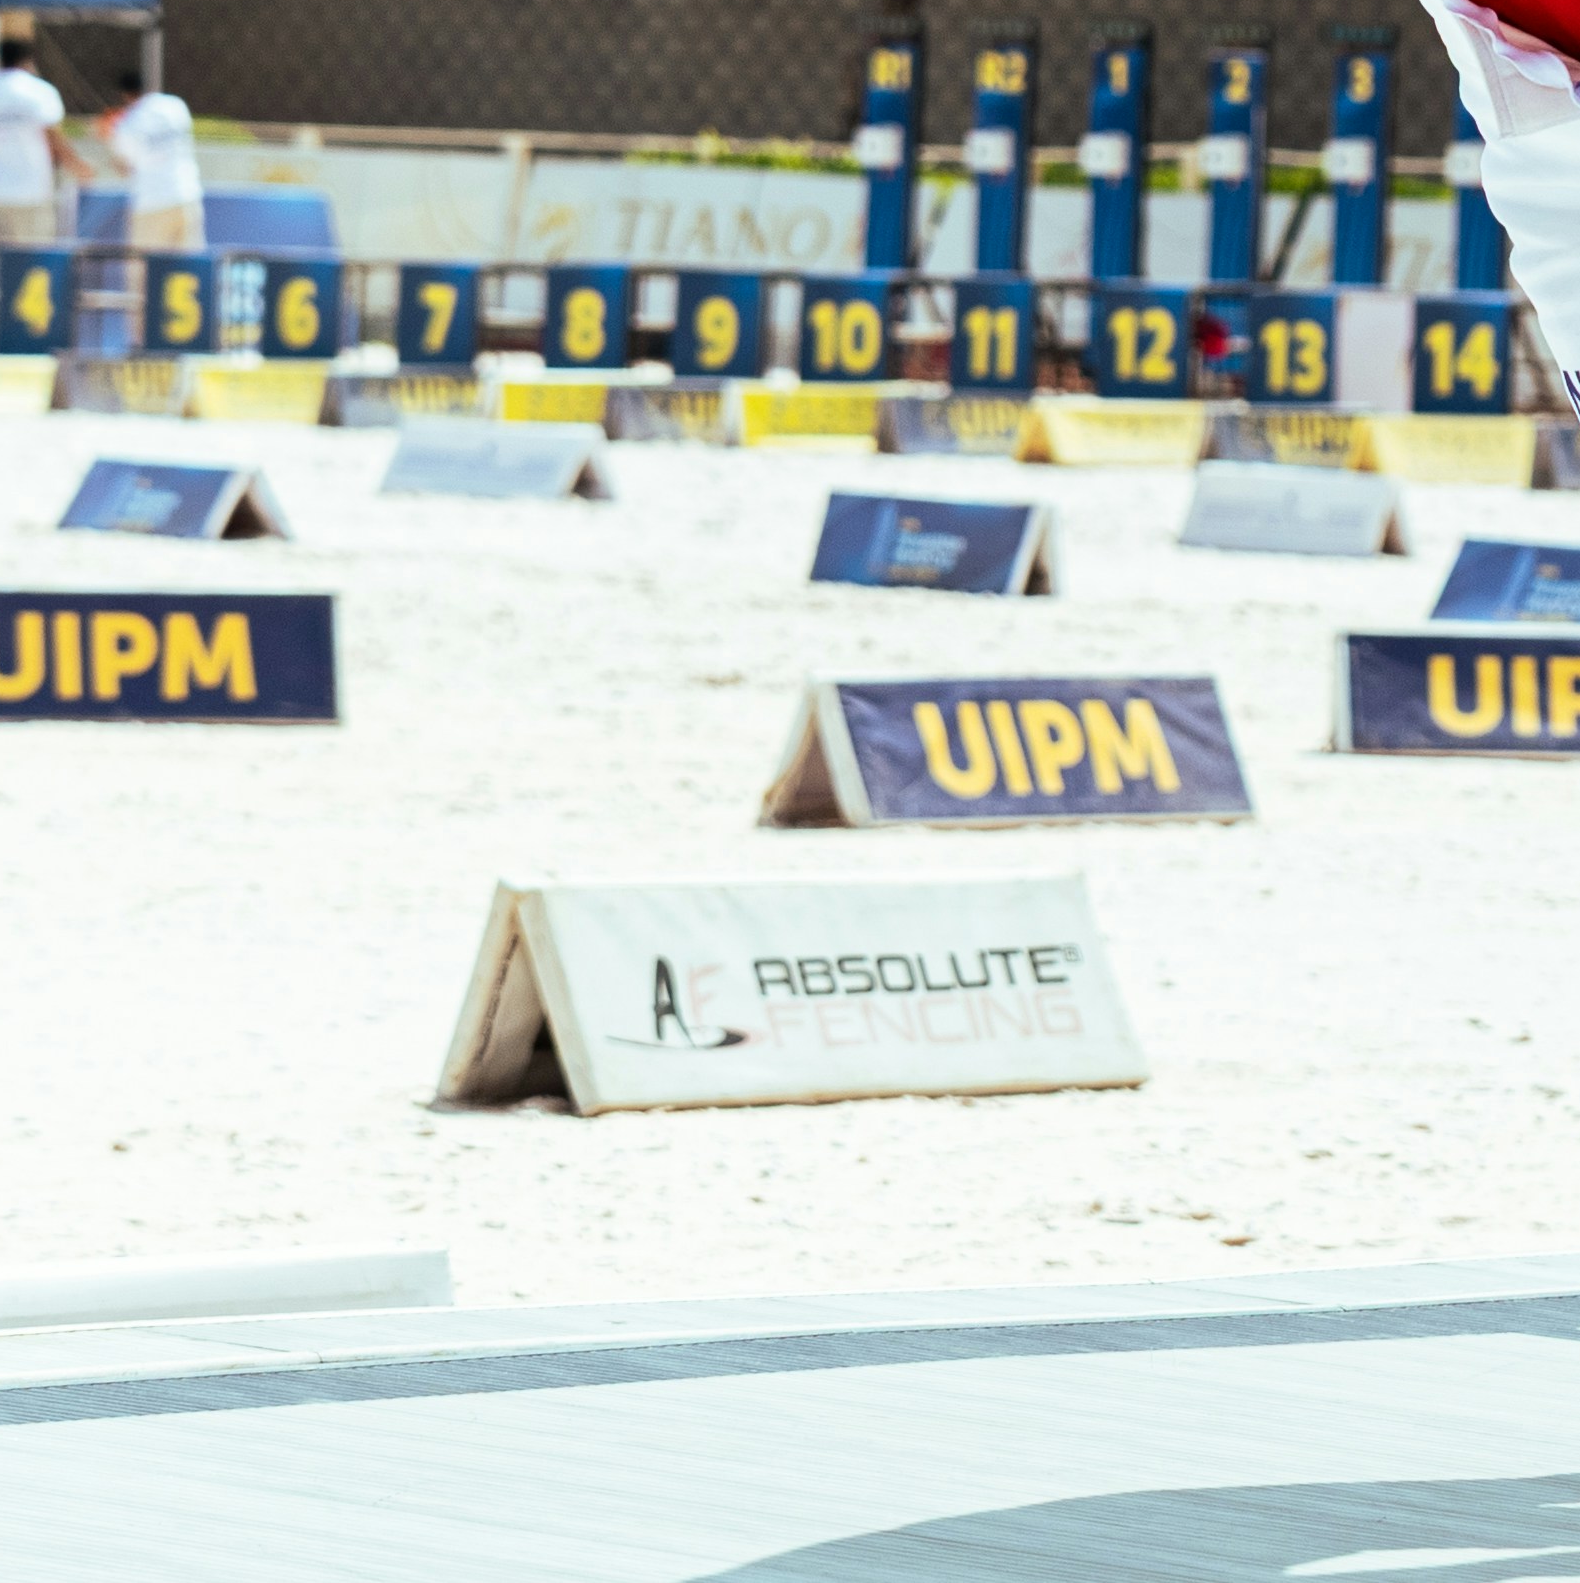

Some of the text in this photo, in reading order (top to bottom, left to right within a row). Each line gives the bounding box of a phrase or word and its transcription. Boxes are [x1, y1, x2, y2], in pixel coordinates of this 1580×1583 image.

[1106, 53, 1129, 95] 1
[15, 267, 54, 335] 4
[163, 272, 202, 343] 5
[277, 277, 320, 348] 6
[419, 282, 457, 353] 7
[561, 287, 606, 361] 8
[694, 296, 739, 369] 9
[810, 300, 882, 374] 10
[964, 306, 1017, 378] 11
[1109, 307, 1176, 382] 12
[1260, 320, 1327, 393] 13
[1424, 322, 1498, 397] 14
[913, 697, 1181, 798] UIPM
[764, 989, 1085, 1050] FENCING
